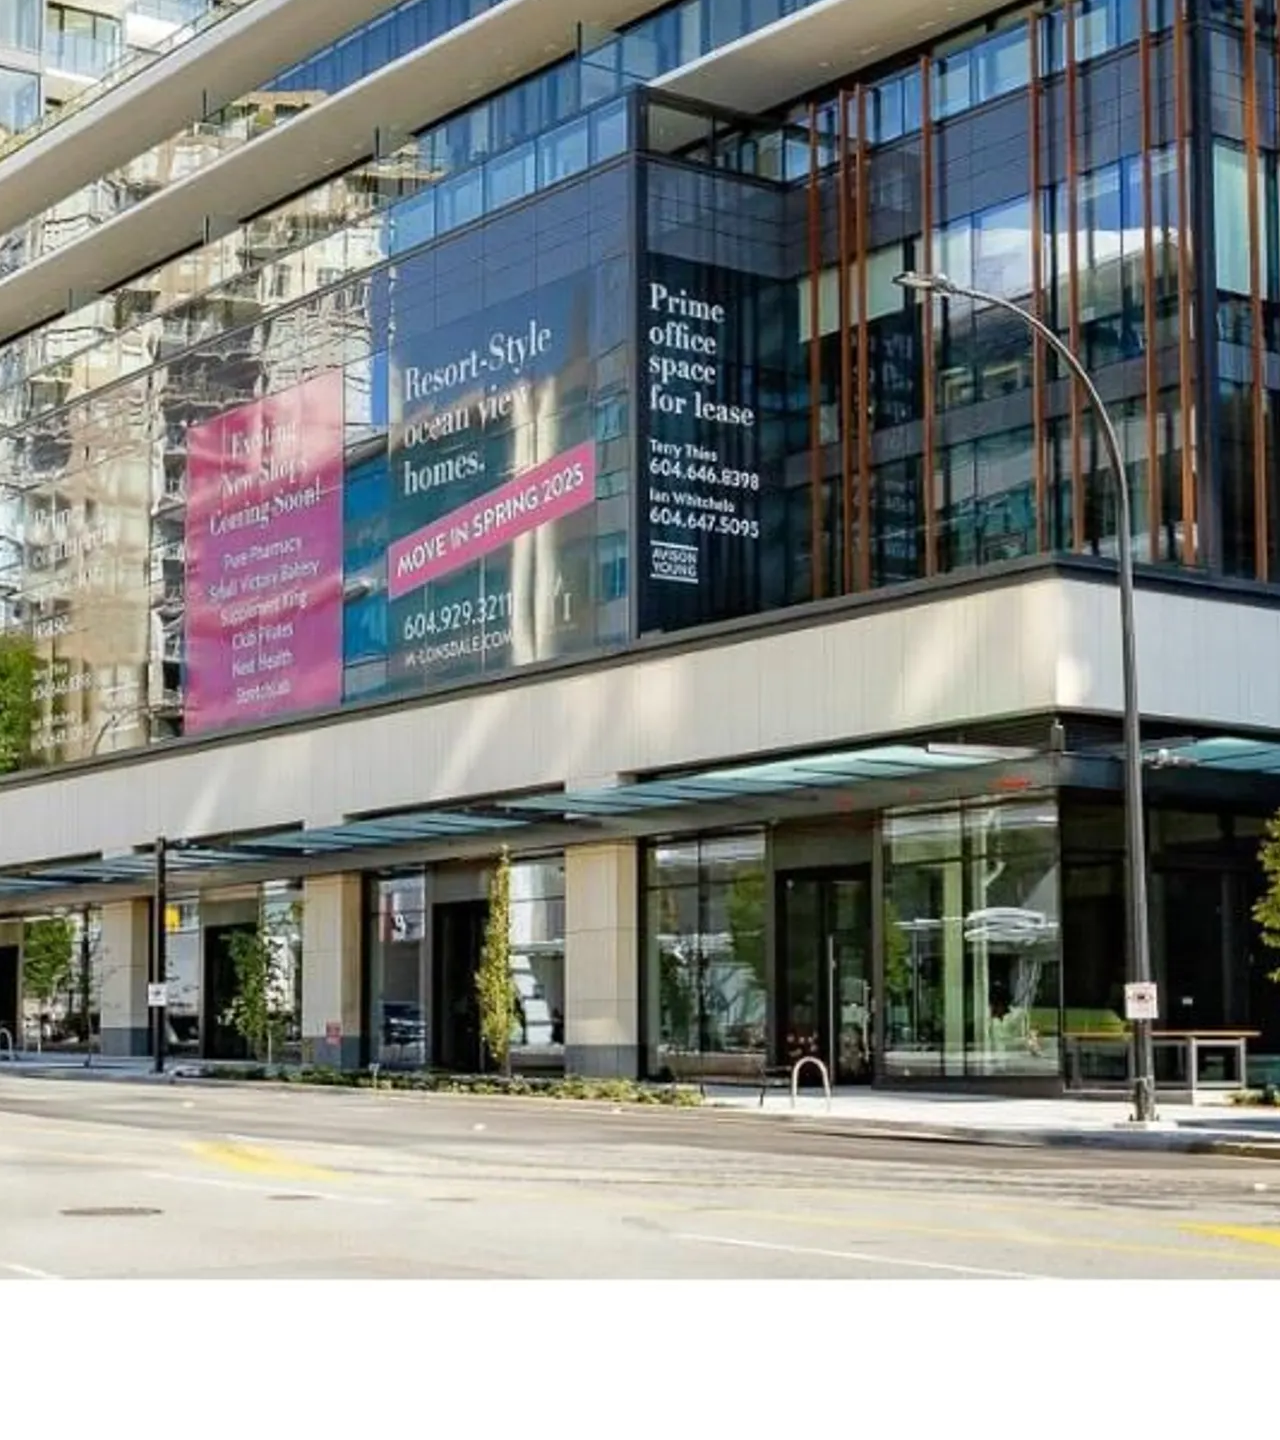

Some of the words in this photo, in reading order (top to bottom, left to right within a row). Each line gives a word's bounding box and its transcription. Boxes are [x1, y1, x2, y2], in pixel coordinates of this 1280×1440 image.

[649, 282, 726, 323] Prime
[649, 321, 717, 355] office
[404, 320, 553, 402] Resort-Style
[649, 354, 717, 385] space
[650, 383, 687, 415] for
[694, 391, 756, 427] lease
[404, 406, 470, 448] ocean
[404, 450, 486, 496] homes.
[209, 499, 270, 536] Coming
[273, 473, 321, 514] Soon!
[650, 486, 671, 503] Ian
[397, 532, 448, 578] MOVE
[451, 519, 471, 550] IN
[472, 485, 539, 539] SPRING
[543, 462, 585, 503] 2025
[650, 505, 760, 539] 604.647.5095
[652, 561, 698, 578] YOUNG
[404, 590, 513, 641] 604.929.3211
